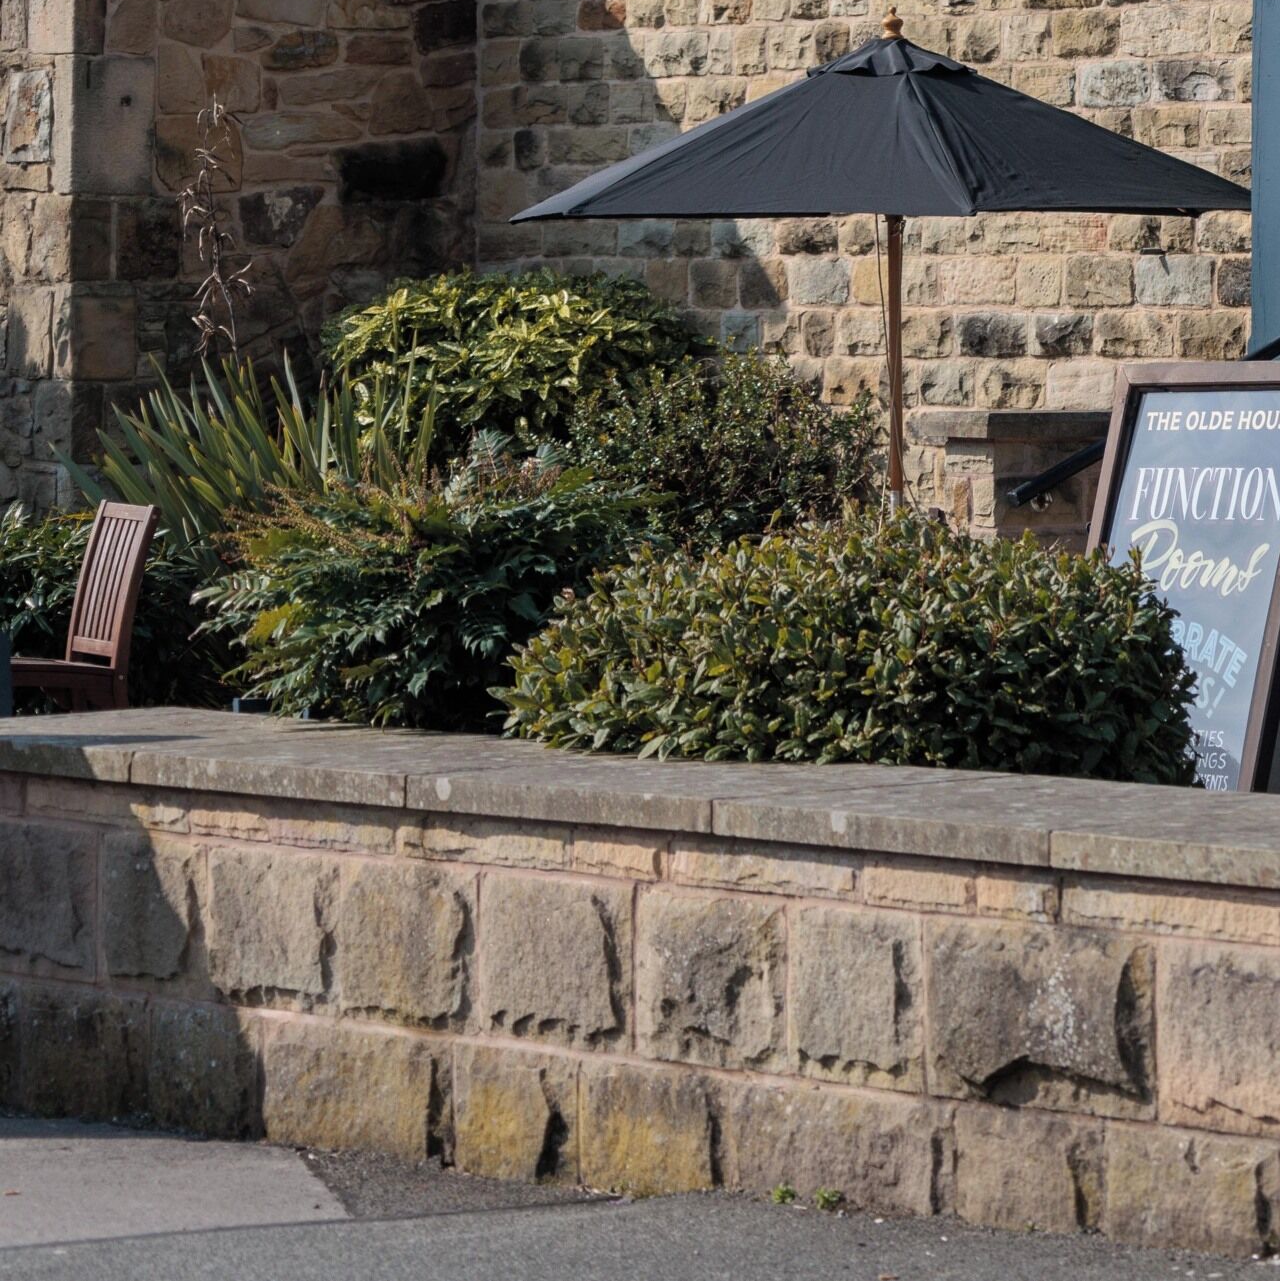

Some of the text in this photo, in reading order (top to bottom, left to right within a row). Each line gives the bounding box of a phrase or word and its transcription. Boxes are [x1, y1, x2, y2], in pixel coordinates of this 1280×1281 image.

[1147, 411, 1182, 431] THE
[1185, 411, 1235, 431] OLDE
[1171, 619, 1248, 688] BRATE
